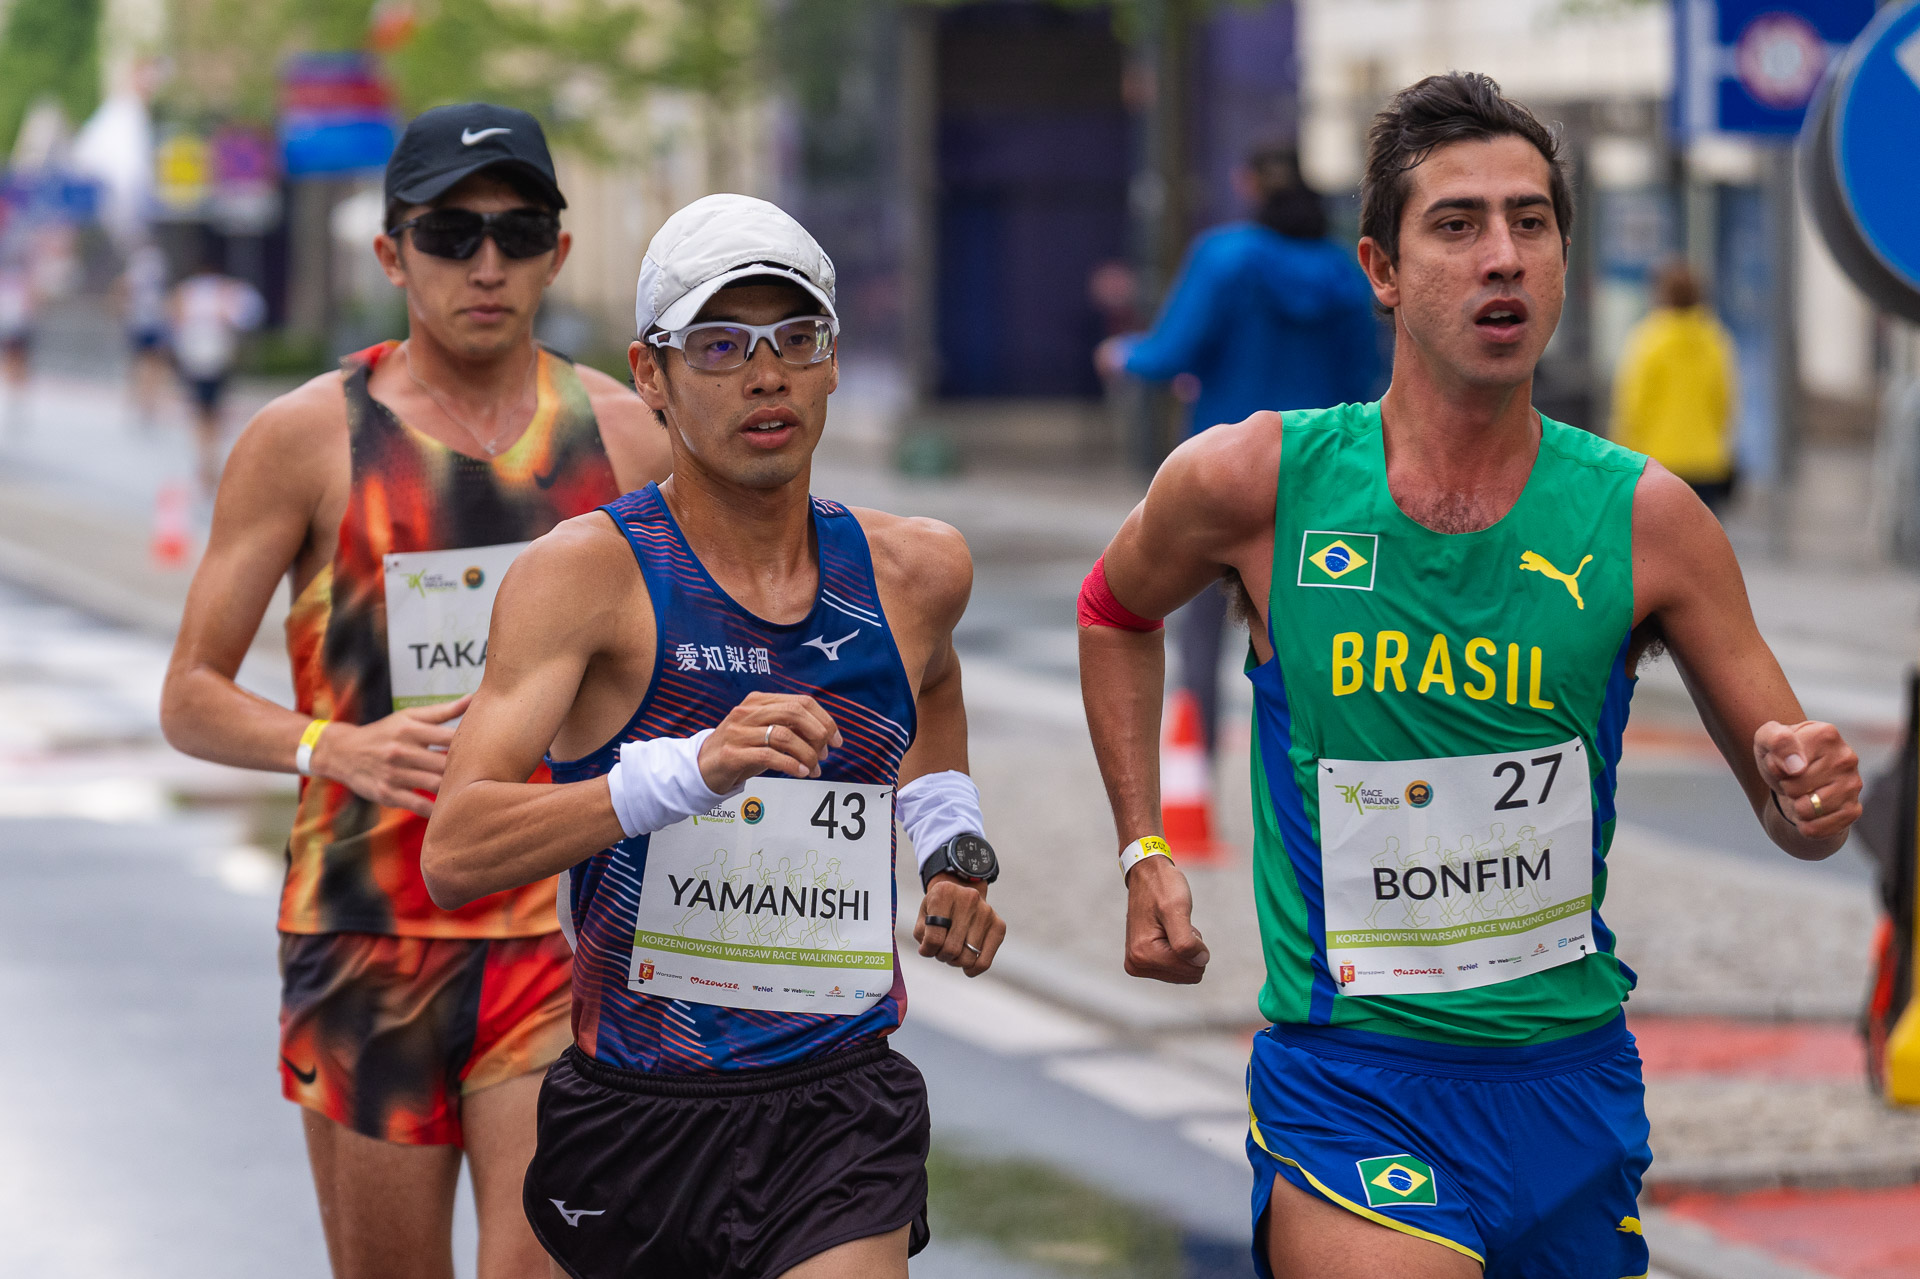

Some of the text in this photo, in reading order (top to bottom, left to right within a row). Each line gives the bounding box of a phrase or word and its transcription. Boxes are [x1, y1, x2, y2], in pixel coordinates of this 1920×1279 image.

[1332, 630, 1555, 710] BRASIL
[1361, 789, 1383, 797] RACE
[1361, 797, 1400, 805] WALKING
[1492, 752, 1563, 811] 27
[810, 790, 866, 841] 43
[667, 874, 869, 921] YAMANISHI
[1373, 848, 1551, 900] BONFIM
[1336, 899, 1586, 944] KORZENIOWSKI WARSAW RACE WALKING CUP 2025
[642, 934, 885, 965] KORZENIOWSKI WARSAW RACE WALKING CUP 2025
